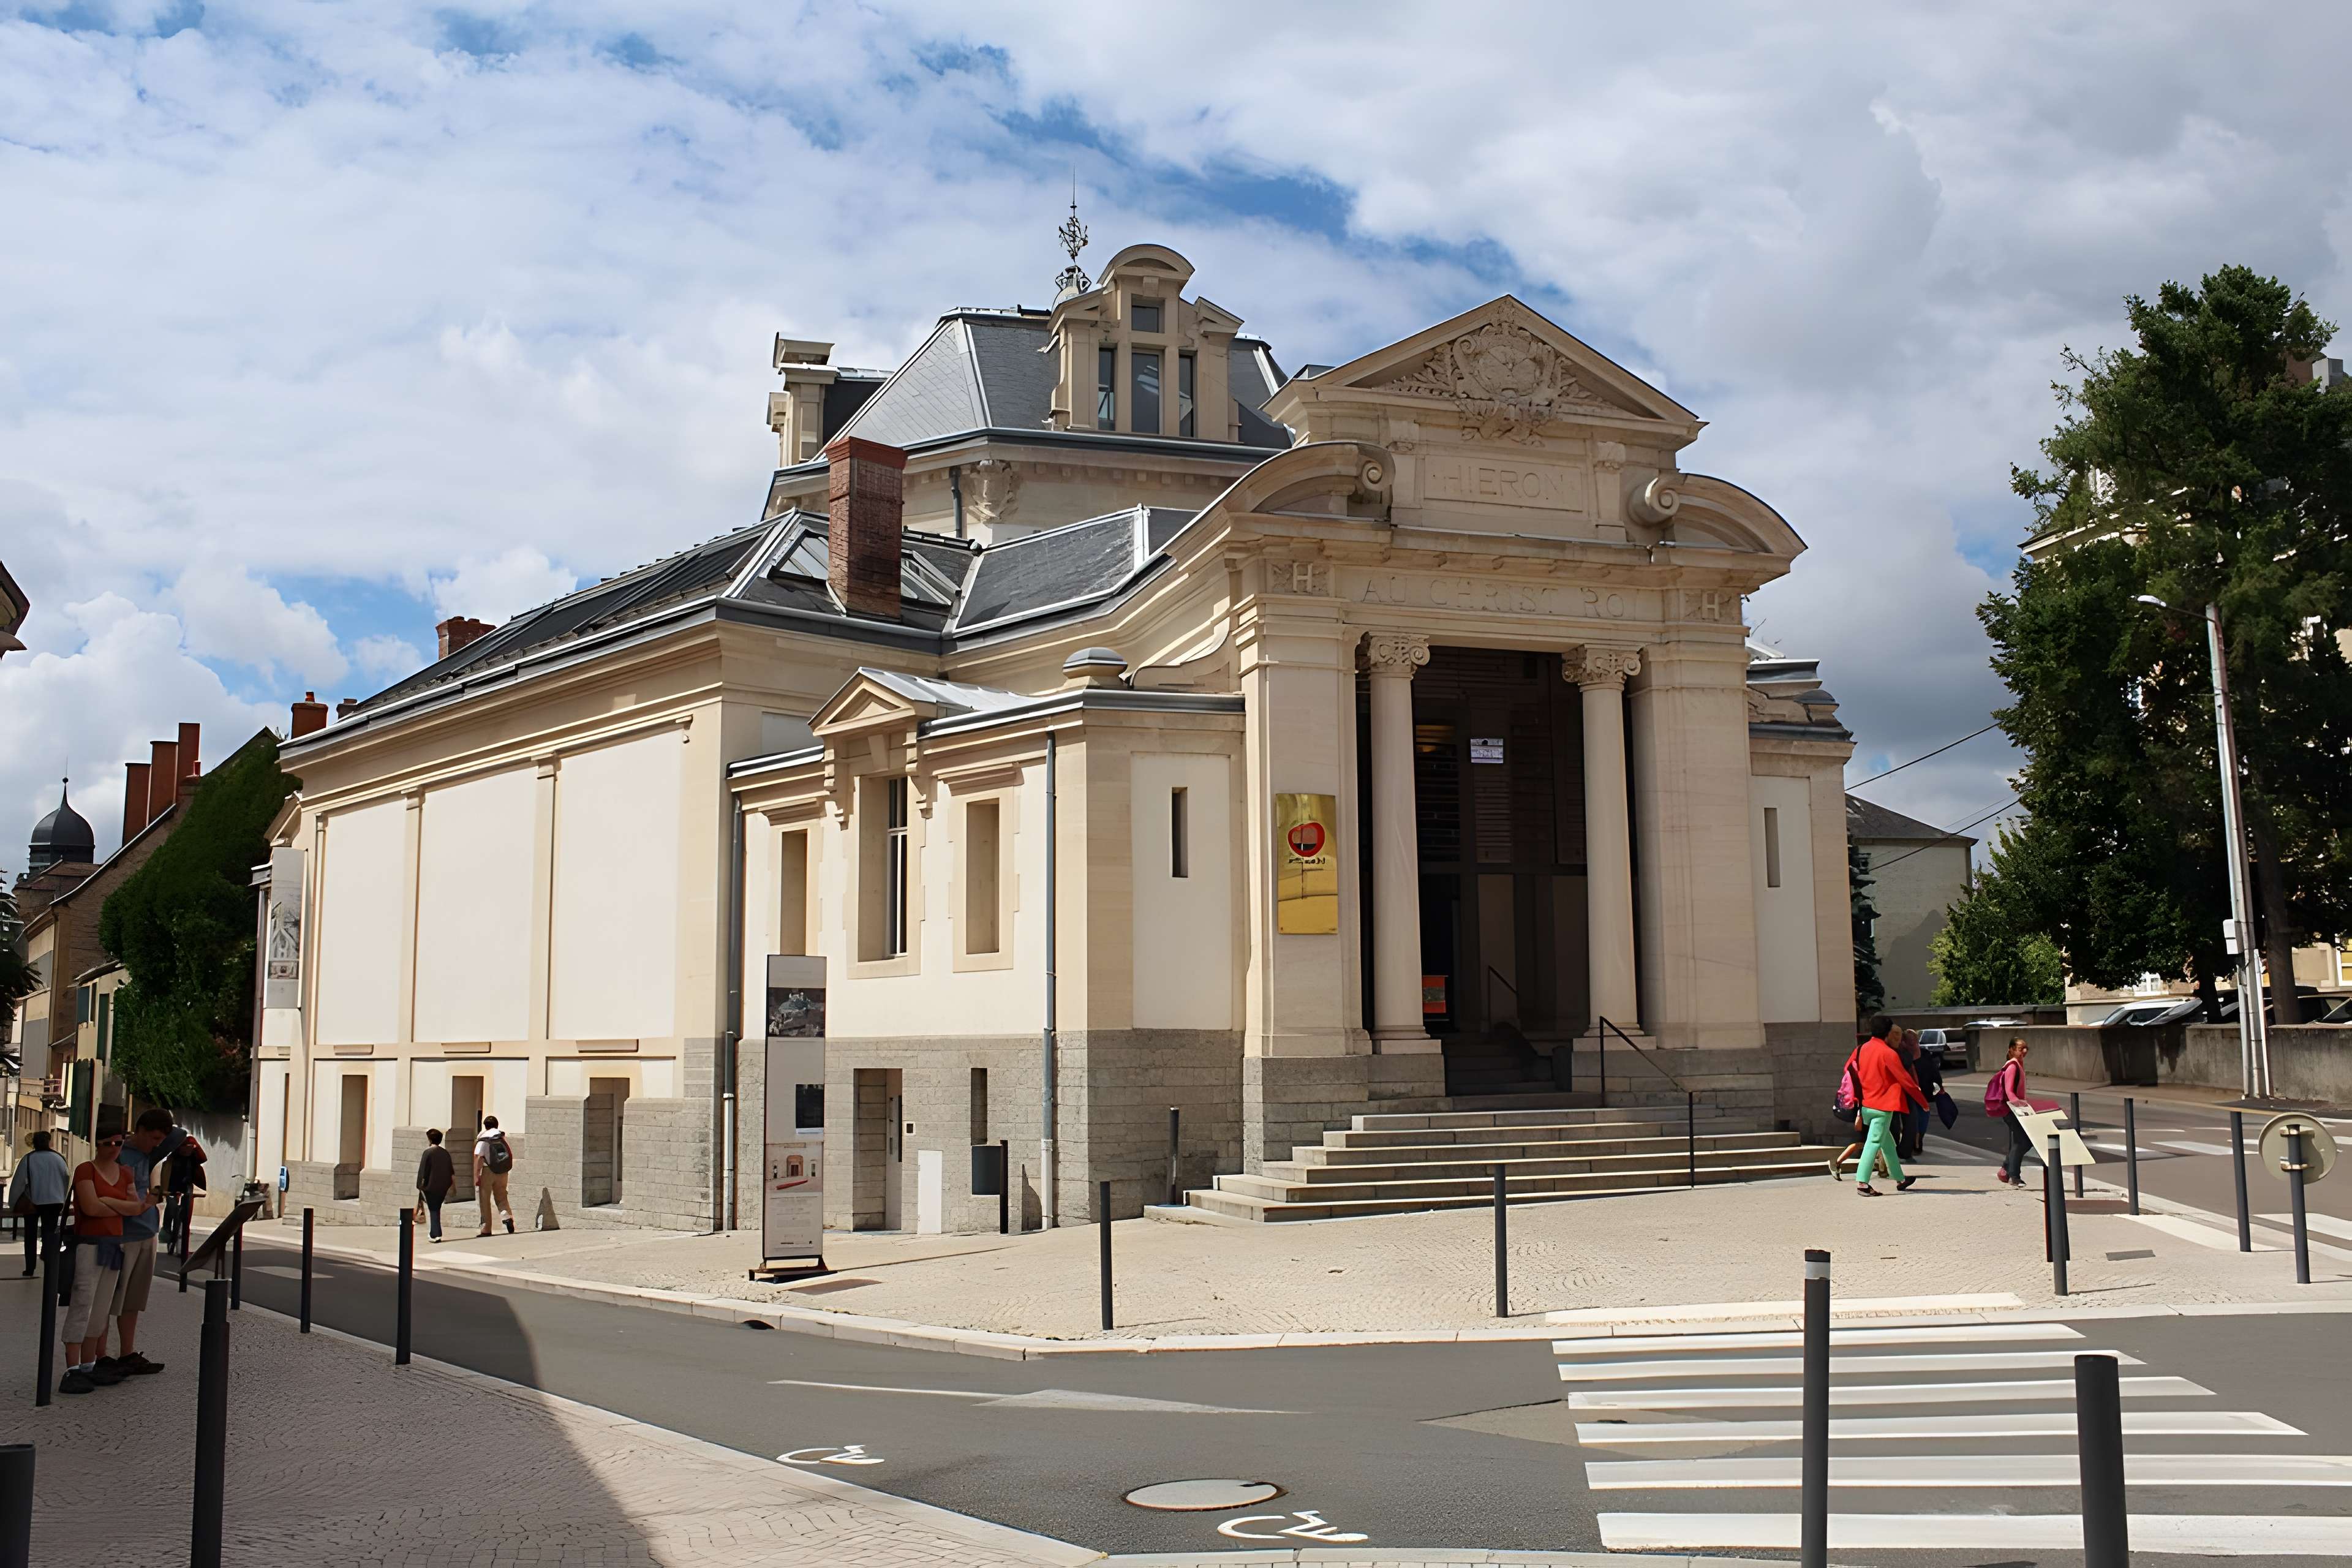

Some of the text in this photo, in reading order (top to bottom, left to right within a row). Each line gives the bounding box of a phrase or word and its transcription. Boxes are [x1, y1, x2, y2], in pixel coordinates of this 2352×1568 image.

[1444, 465, 1564, 499] HIERON
[1292, 562, 1313, 592] H
[1362, 578, 1407, 602] AU
[1430, 579, 1559, 613] CHRIST
[1702, 592, 1719, 621] H
